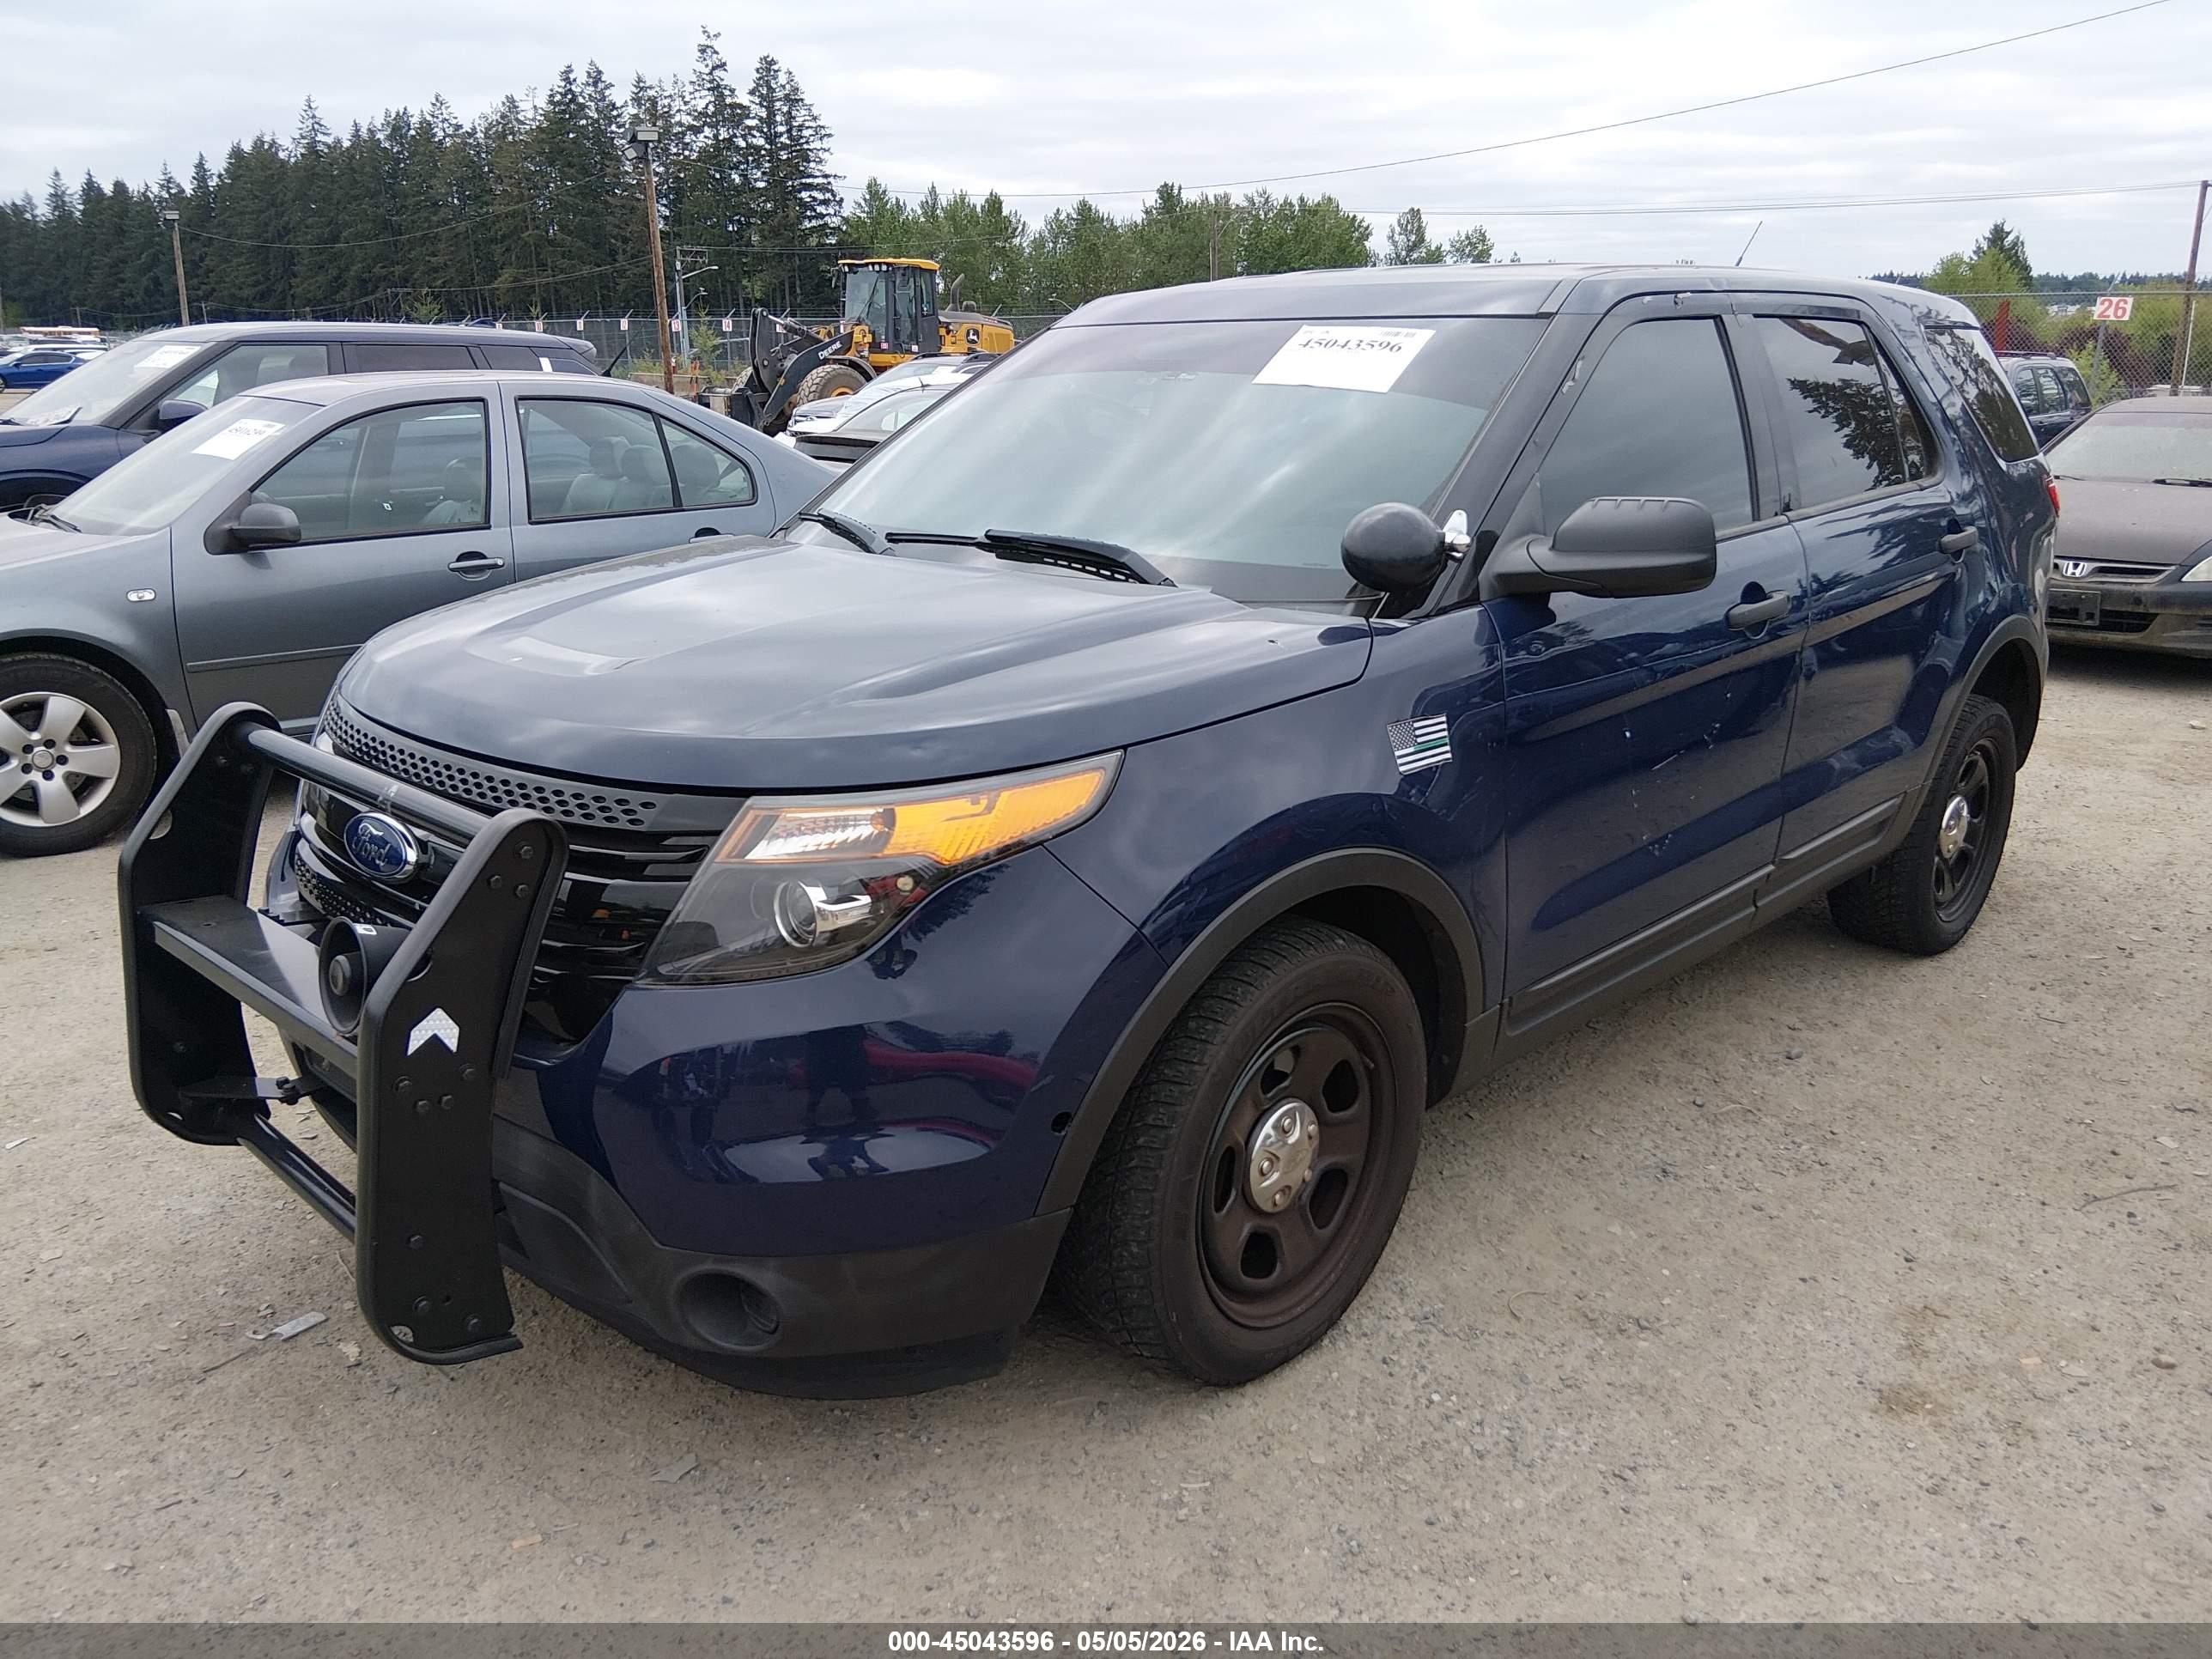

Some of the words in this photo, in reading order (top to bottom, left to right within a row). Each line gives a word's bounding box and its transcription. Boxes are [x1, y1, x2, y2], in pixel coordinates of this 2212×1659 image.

[2097, 298, 2129, 319] 26
[723, 319, 731, 331] 14
[818, 341, 843, 360] DEERE
[1297, 337, 1403, 354] 45043596
[352, 823, 392, 866] Ford
